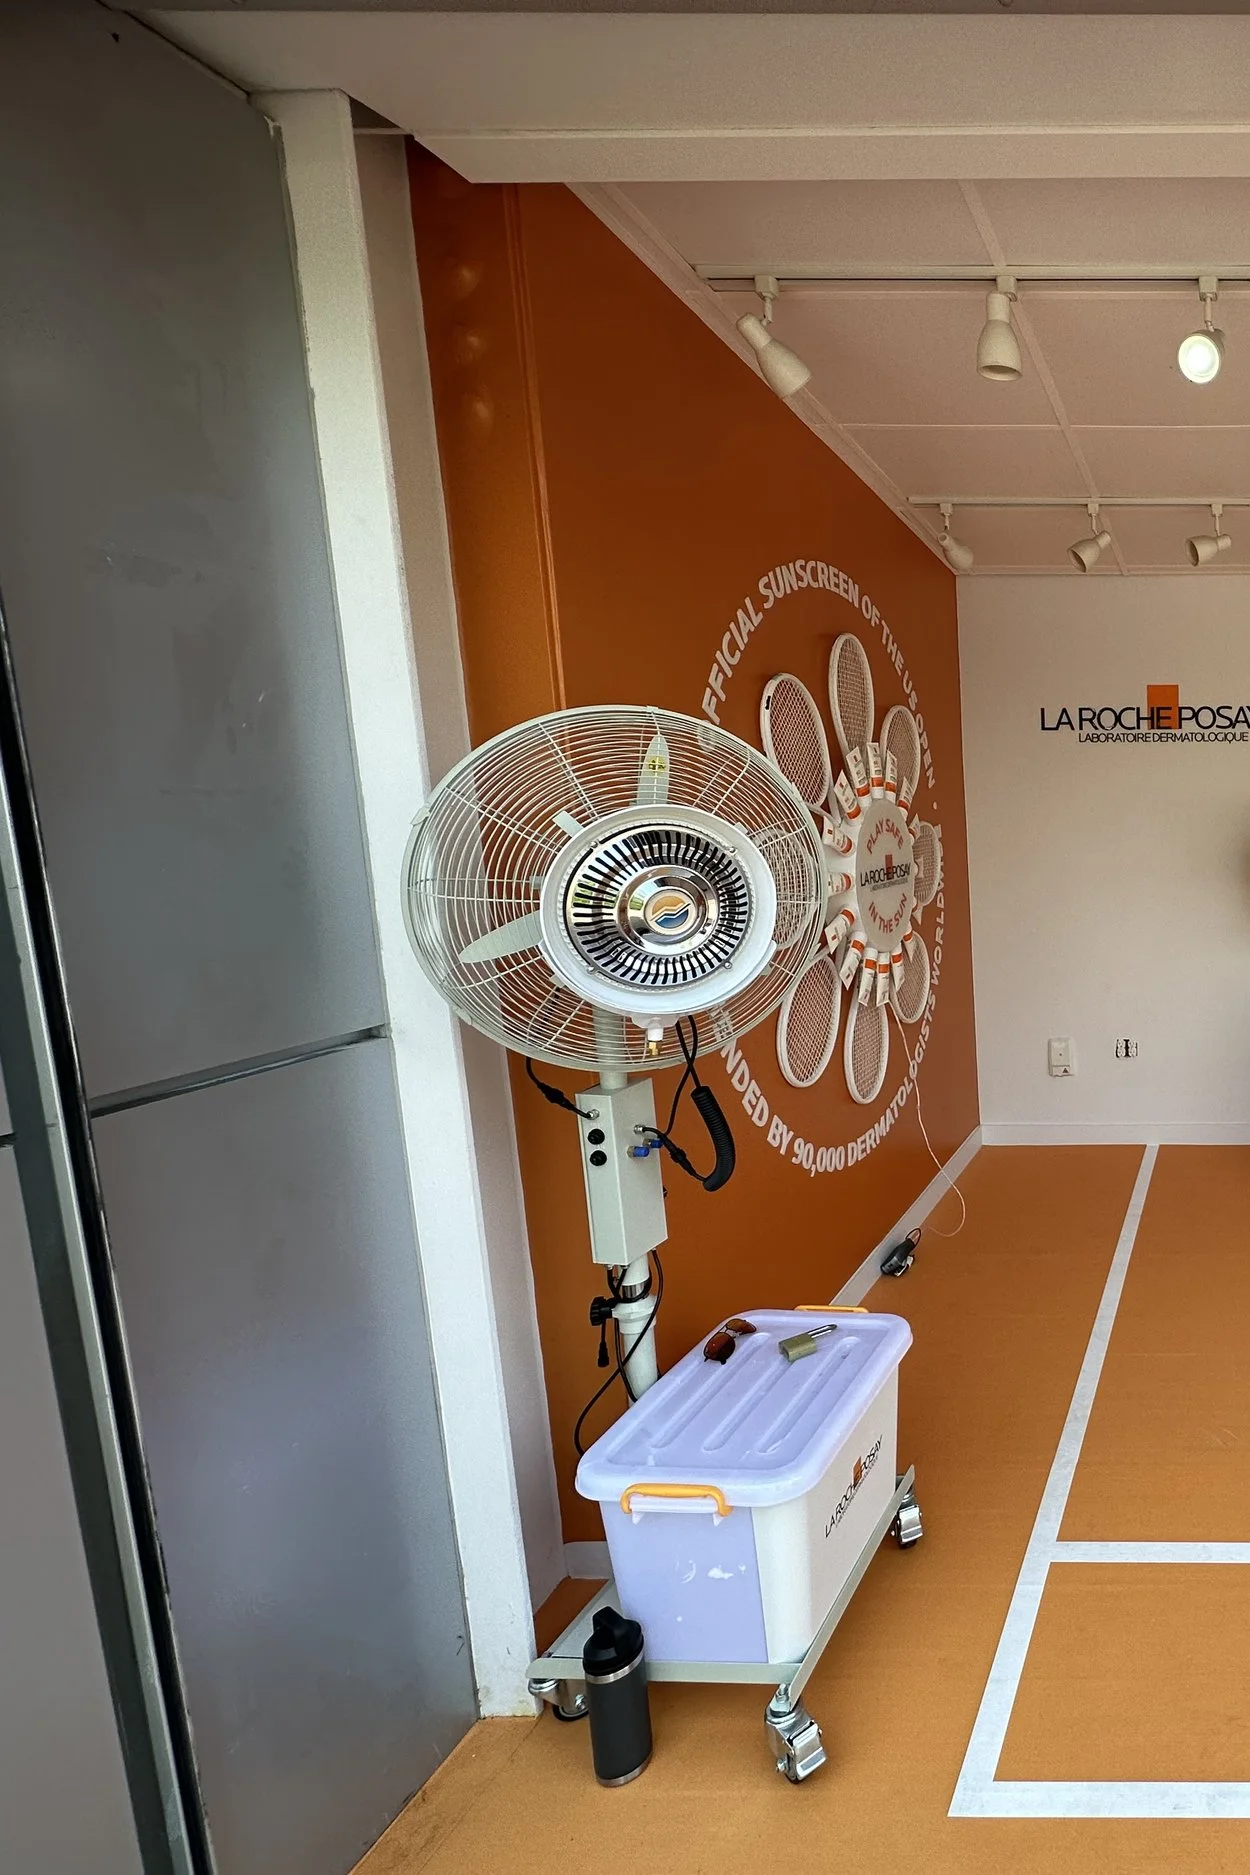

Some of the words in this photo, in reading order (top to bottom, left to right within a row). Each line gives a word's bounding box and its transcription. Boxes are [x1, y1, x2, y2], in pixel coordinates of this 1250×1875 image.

[758, 559, 860, 609] SUNSCREEN
[861, 595, 881, 627] OF
[880, 620, 904, 676] THE
[903, 670, 918, 711] US
[916, 713, 936, 789] OPEN
[1040, 707, 1075, 731] LA
[1078, 706, 1173, 731] ROCHE
[1078, 732, 1151, 743] LABORATOIRE
[1152, 731, 1249, 744] DERMATOLOGIQUE
[866, 819, 885, 855] PLAY
[885, 818, 904, 850] SAFE
[860, 871, 870, 887] LA
[868, 901, 879, 922] IN
[878, 917, 894, 933] THE
[894, 893, 908, 928] SUN
[766, 1114, 795, 1156] BY
[791, 1137, 845, 1177] 90,000
[847, 990, 937, 1167] DERMATOLOGISTS
[825, 1514, 835, 1538] LA
